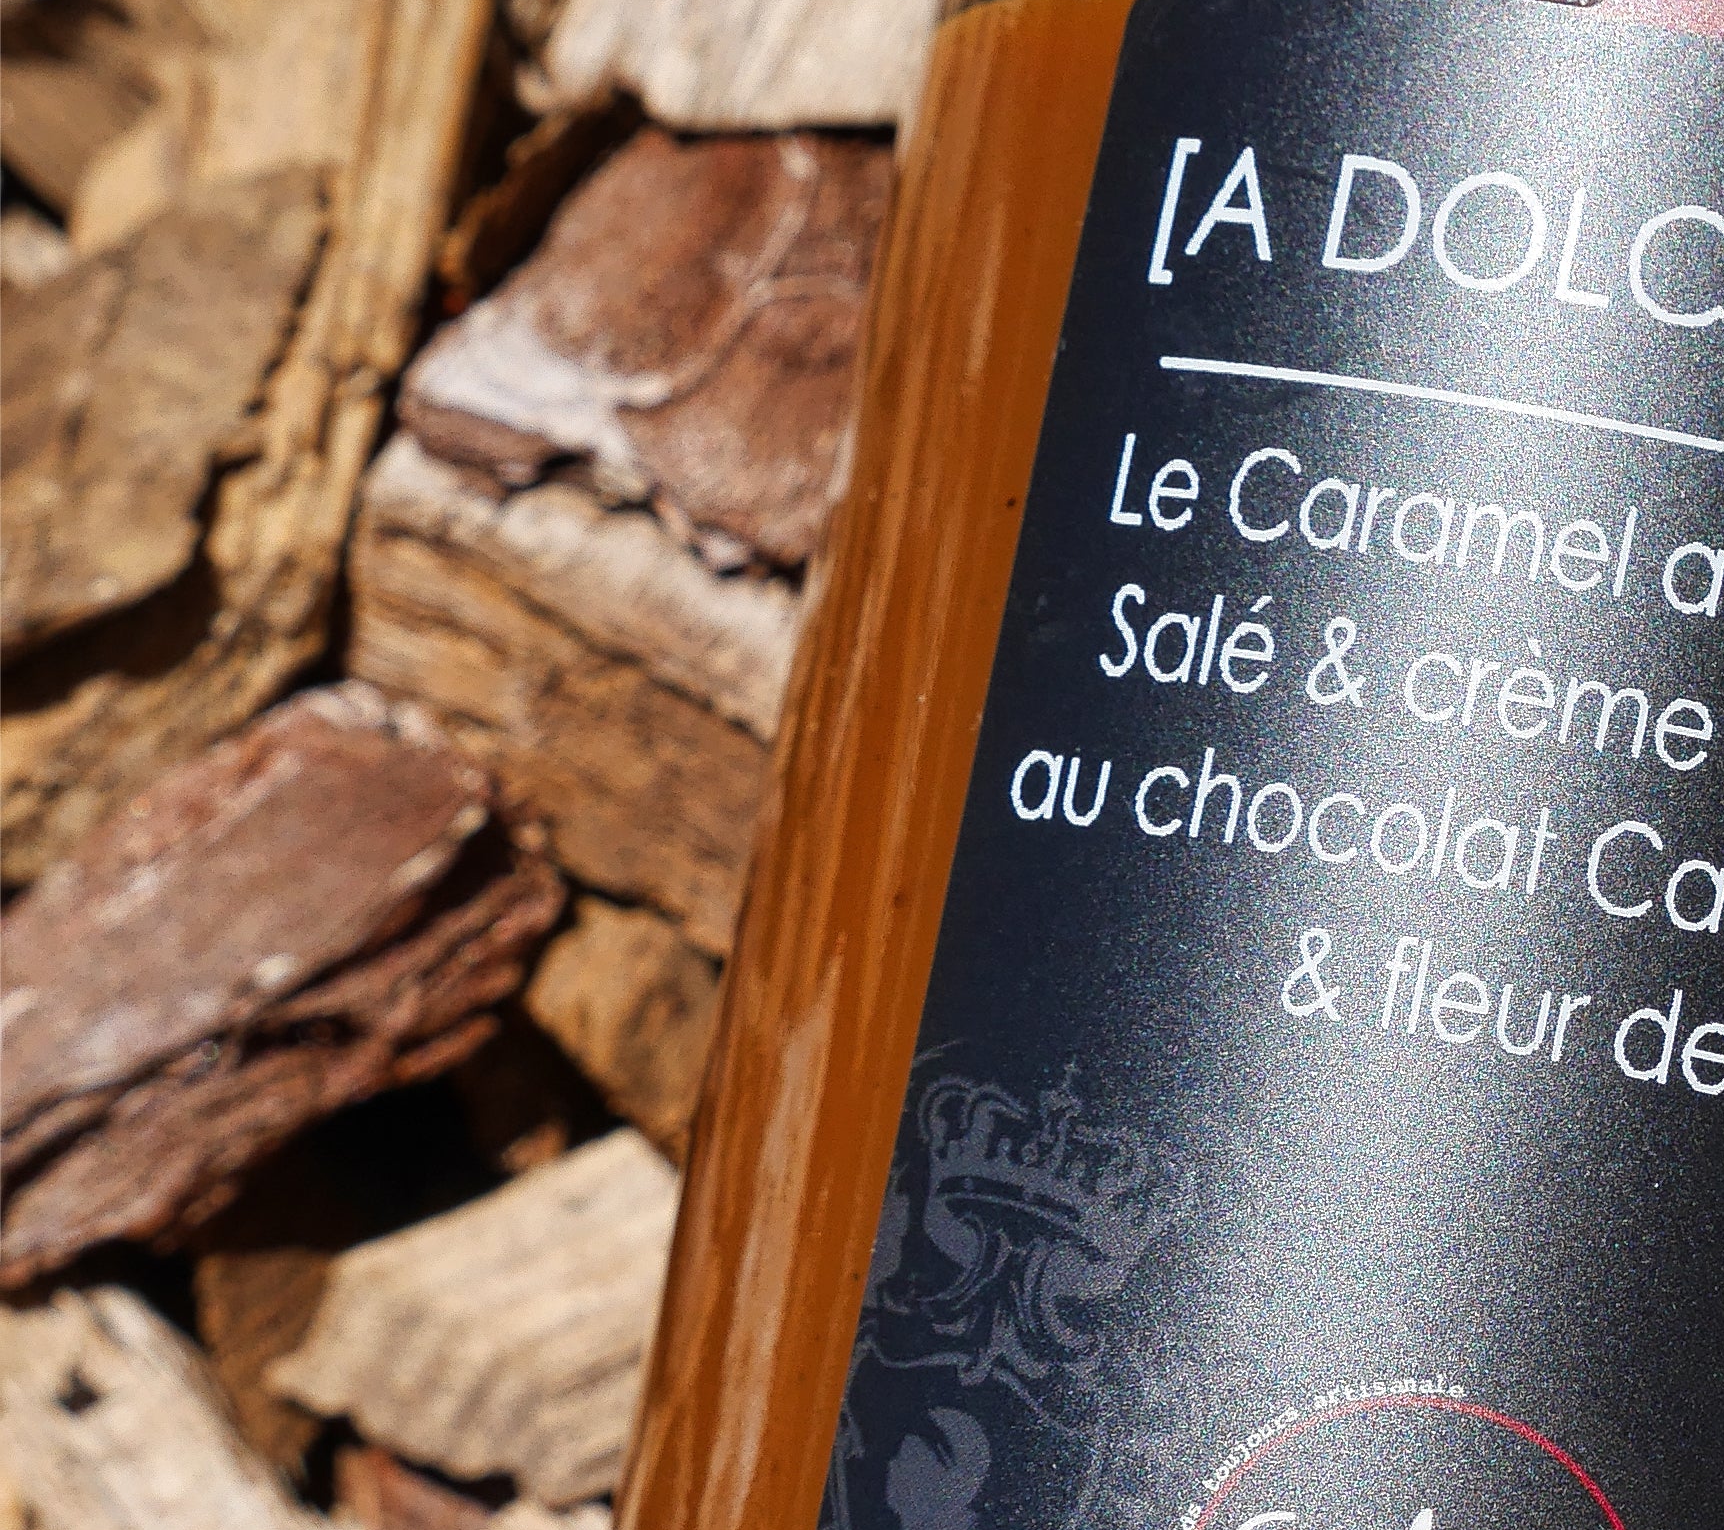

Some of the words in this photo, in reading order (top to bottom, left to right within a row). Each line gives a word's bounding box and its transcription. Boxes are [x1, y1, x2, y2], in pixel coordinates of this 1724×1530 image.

[1148, 137, 1273, 285] [A
[1109, 433, 1200, 531] Le
[1226, 447, 1638, 599] Caramel
[1099, 582, 1275, 694] Salé
[1307, 617, 1366, 707] &
[1404, 640, 1714, 772] crème
[1011, 751, 1110, 829] au
[1135, 747, 1561, 897] chocolat
[1280, 925, 1341, 1022] &
[1379, 937, 1592, 1064] fleur
